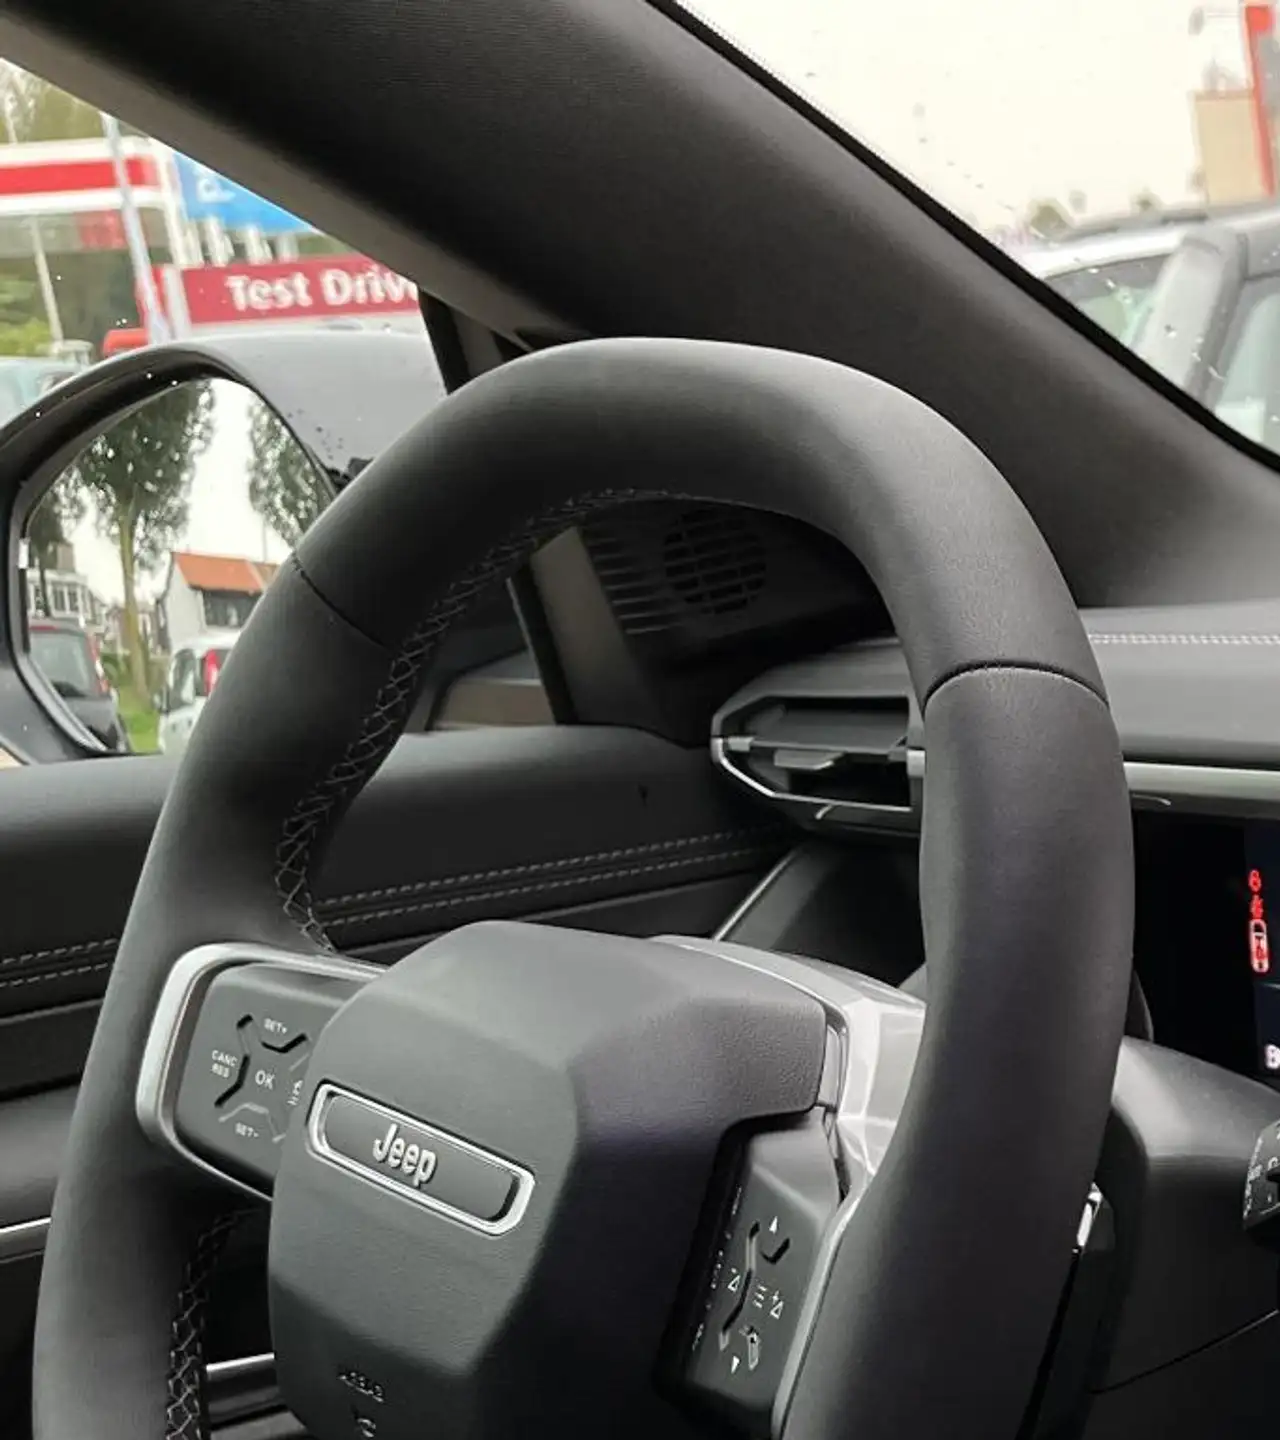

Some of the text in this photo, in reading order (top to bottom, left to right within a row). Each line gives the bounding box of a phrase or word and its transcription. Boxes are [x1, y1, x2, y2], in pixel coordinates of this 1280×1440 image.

[224, 265, 417, 312] Test Driv
[211, 1049, 239, 1068] CANC
[255, 1069, 275, 1090] OK
[372, 1122, 438, 1188] Jeep
